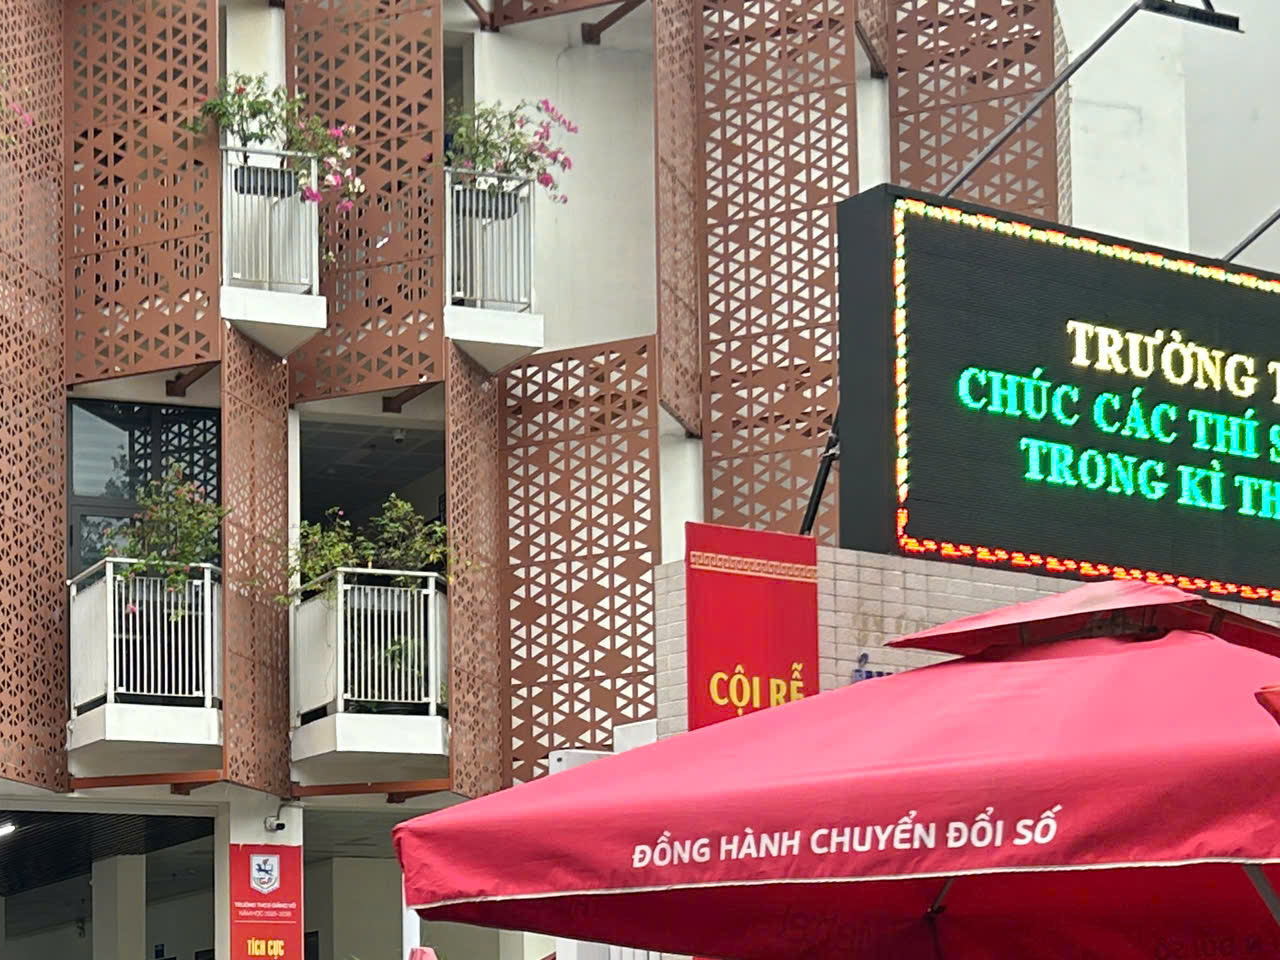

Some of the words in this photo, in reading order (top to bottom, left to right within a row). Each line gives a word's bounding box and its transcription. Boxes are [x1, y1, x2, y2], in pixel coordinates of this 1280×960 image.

[1066, 319, 1258, 398] TRƯỜNG
[957, 366, 1080, 426] CHÚC
[1092, 386, 1178, 444] CÁC
[1187, 408, 1262, 459] THÍ
[1020, 437, 1169, 500] TRONG
[1234, 475, 1280, 520] TH
[709, 664, 761, 717] CỘI
[770, 661, 805, 707] RỄ
[632, 830, 711, 868] ĐỒNG
[719, 827, 801, 861] HÀNH
[810, 810, 936, 854] CHUYỂN
[945, 807, 1004, 849] ĐỔI
[1013, 804, 1064, 846] SỐ
[247, 937, 266, 957] TÍCH
[267, 939, 285, 960] CỰC
